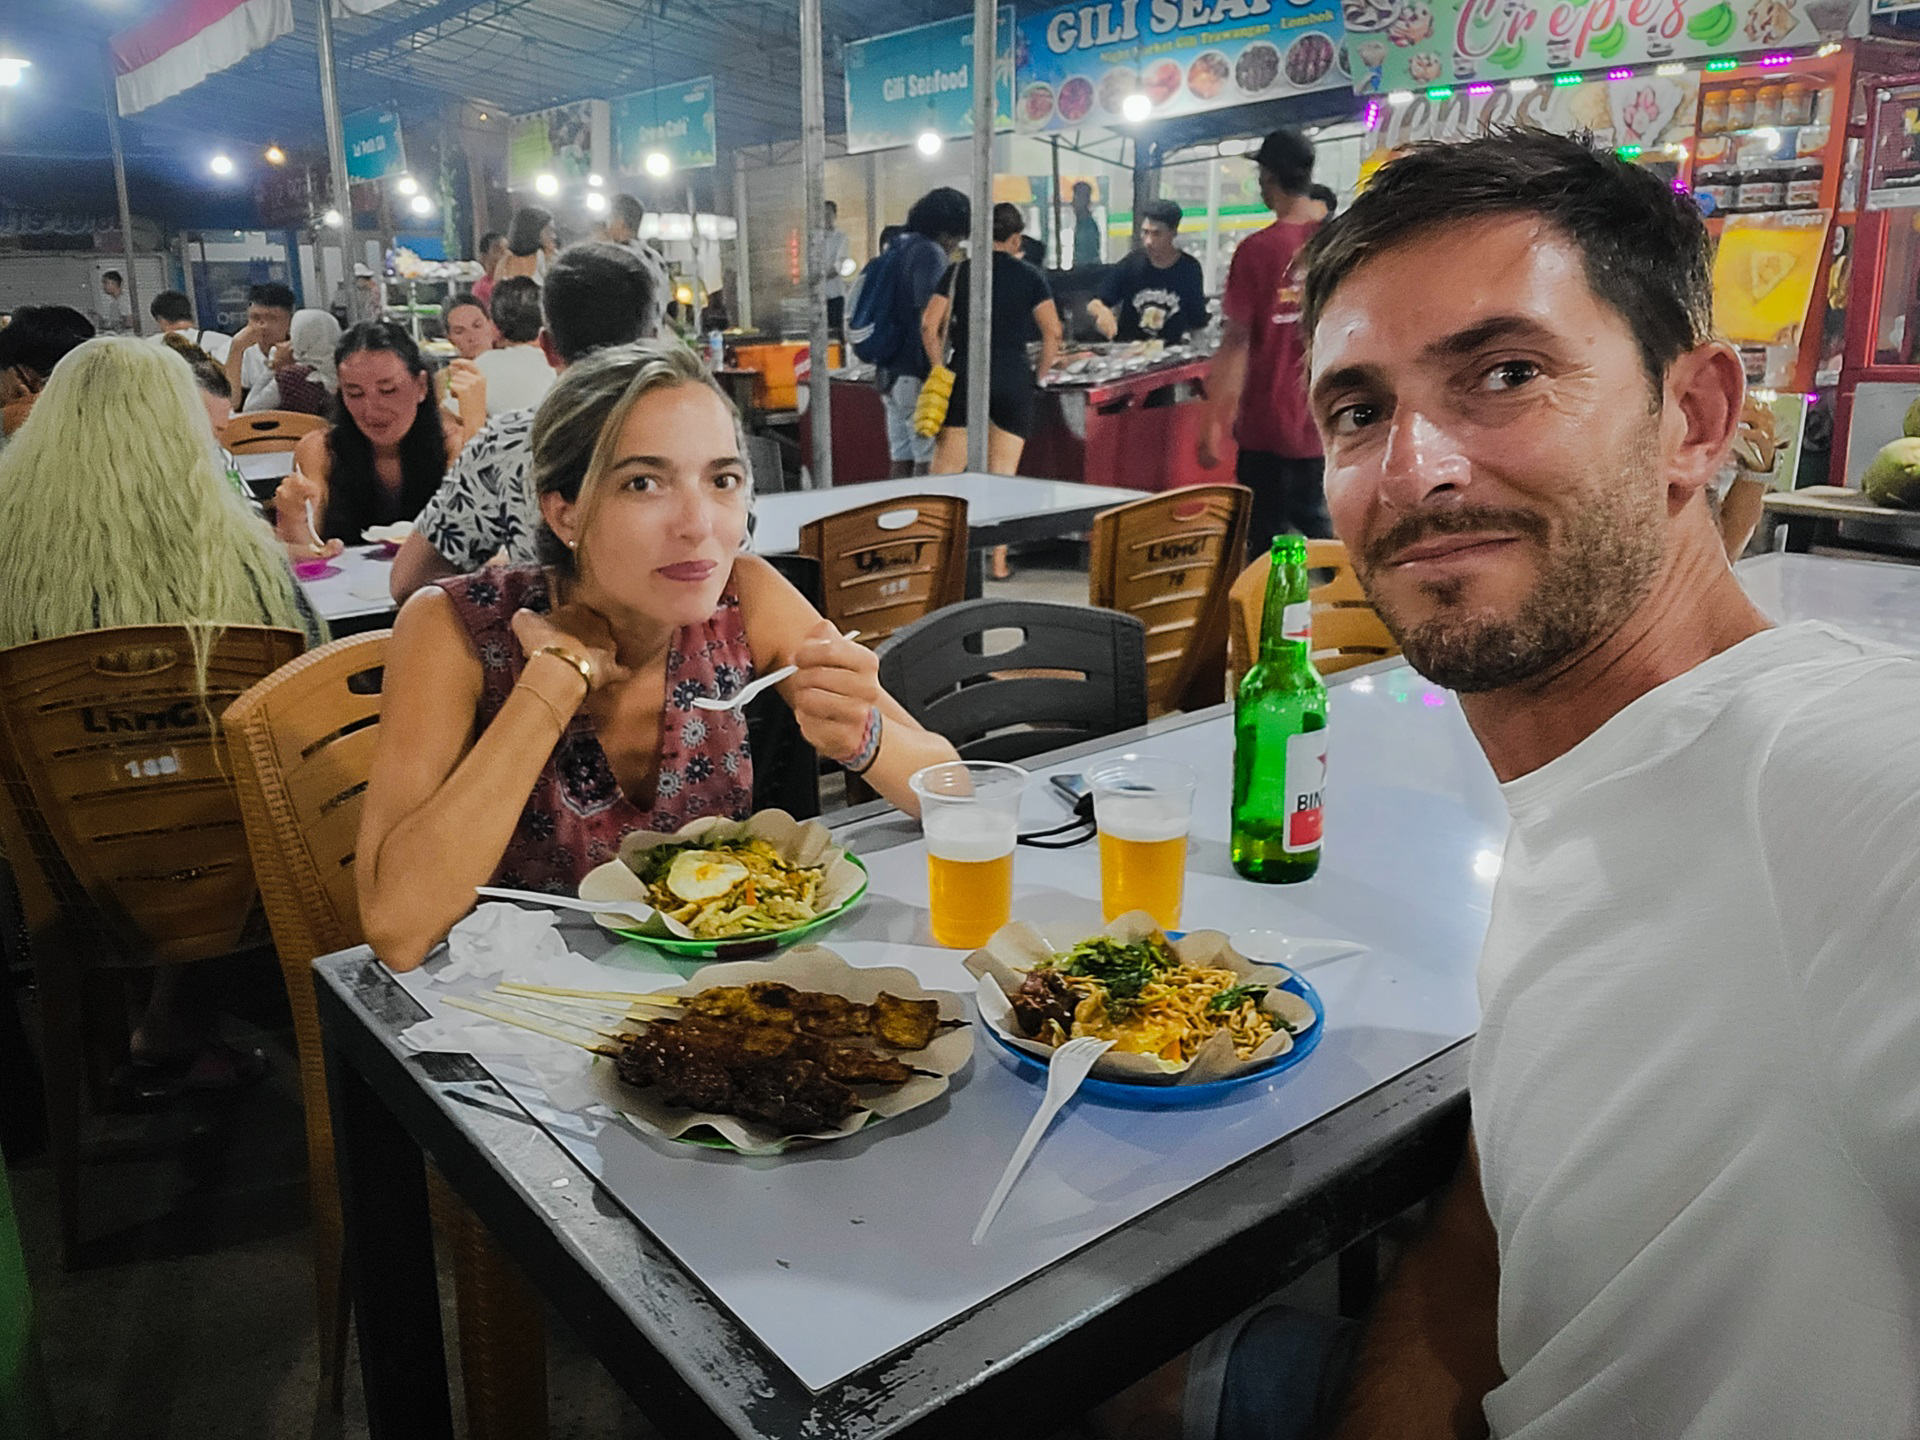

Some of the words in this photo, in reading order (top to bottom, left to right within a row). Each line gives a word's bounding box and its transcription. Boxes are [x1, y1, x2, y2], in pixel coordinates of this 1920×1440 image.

[1047, 0, 1139, 53] GILI
[1150, 0, 1316, 34] SEA
[1456, 0, 1688, 58] Crepes
[883, 77, 905, 102] Gili
[908, 64, 968, 98] Seafood
[1782, 212, 1823, 227] Crepes
